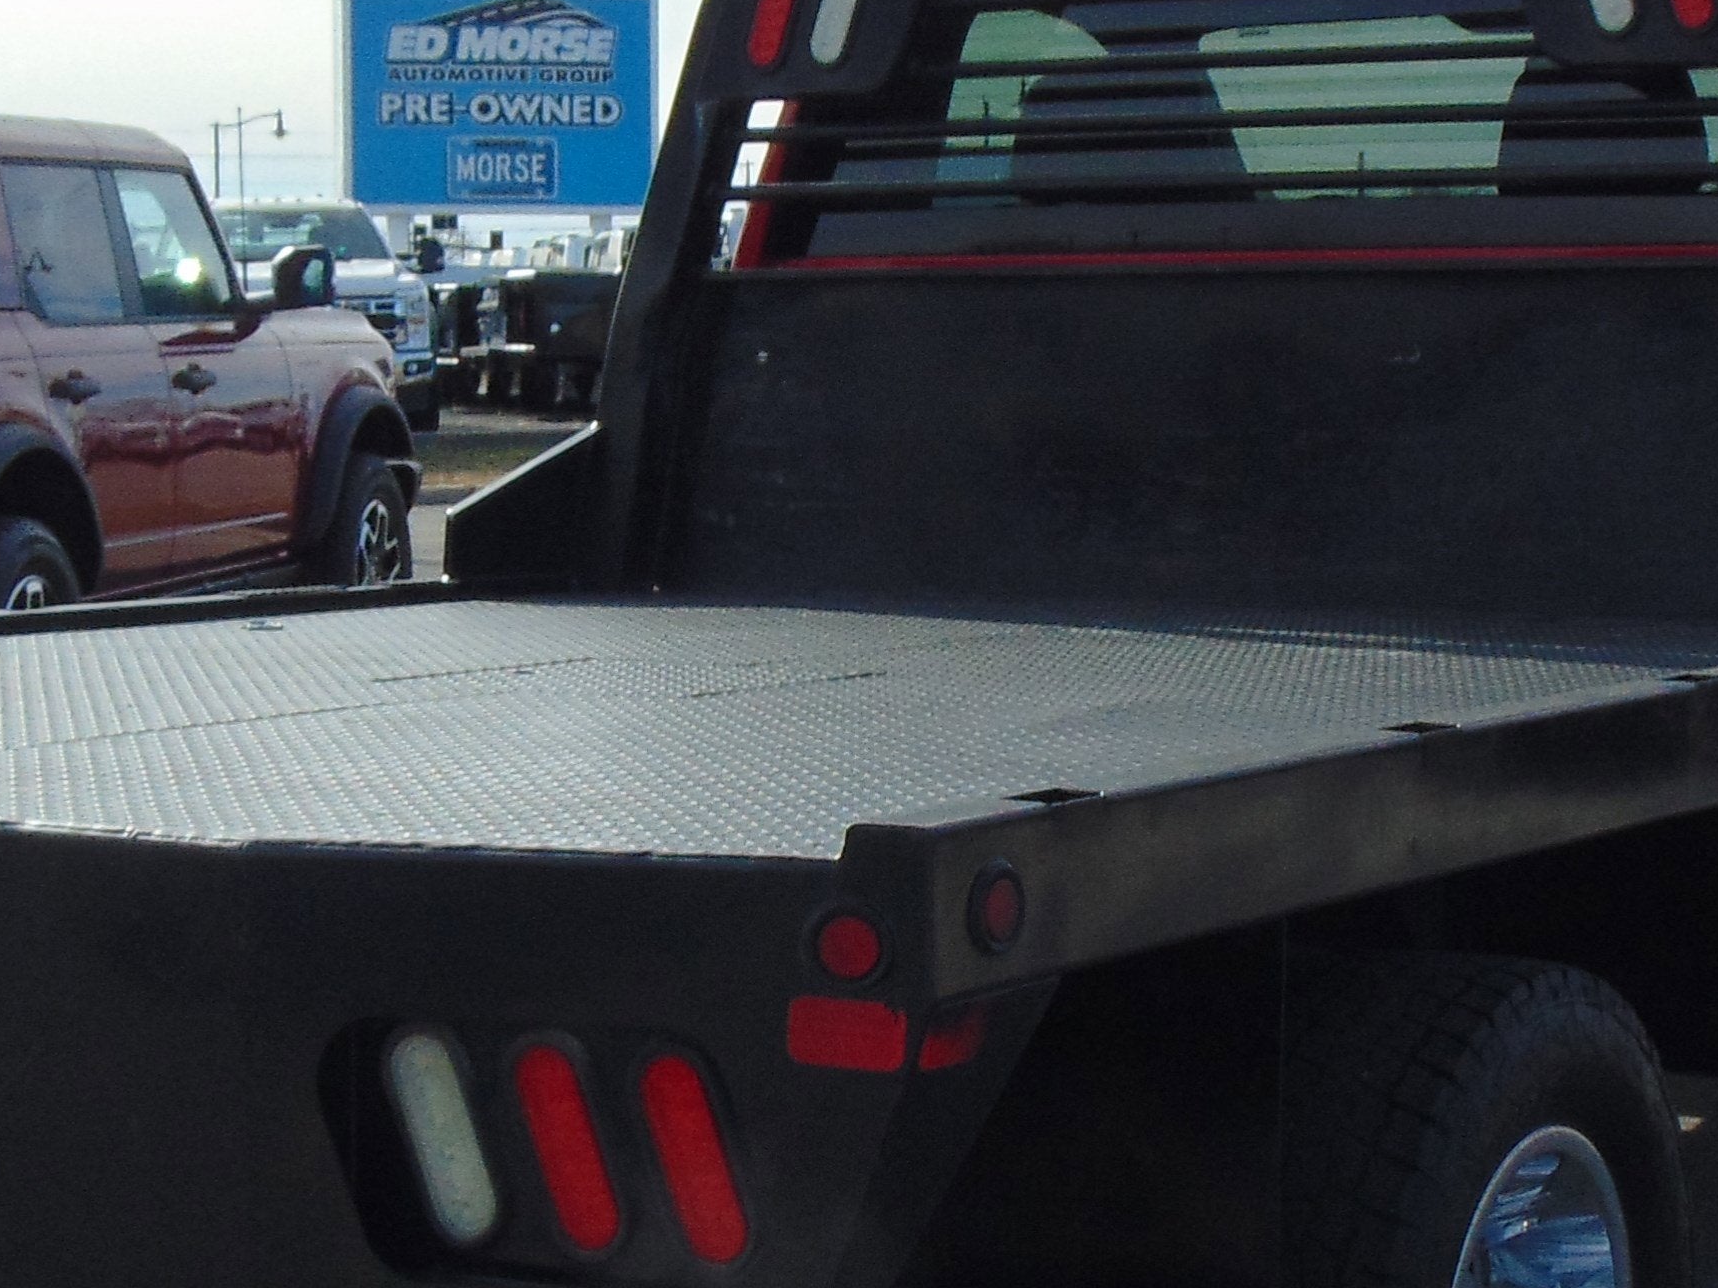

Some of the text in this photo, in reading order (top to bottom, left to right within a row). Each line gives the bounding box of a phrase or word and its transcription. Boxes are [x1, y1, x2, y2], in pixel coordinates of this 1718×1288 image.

[386, 24, 616, 67] ED MORSE
[388, 66, 615, 83] AUTOMOTIVE GROUP
[381, 91, 623, 126] PRE-OWNED
[455, 152, 547, 183] MORSE
